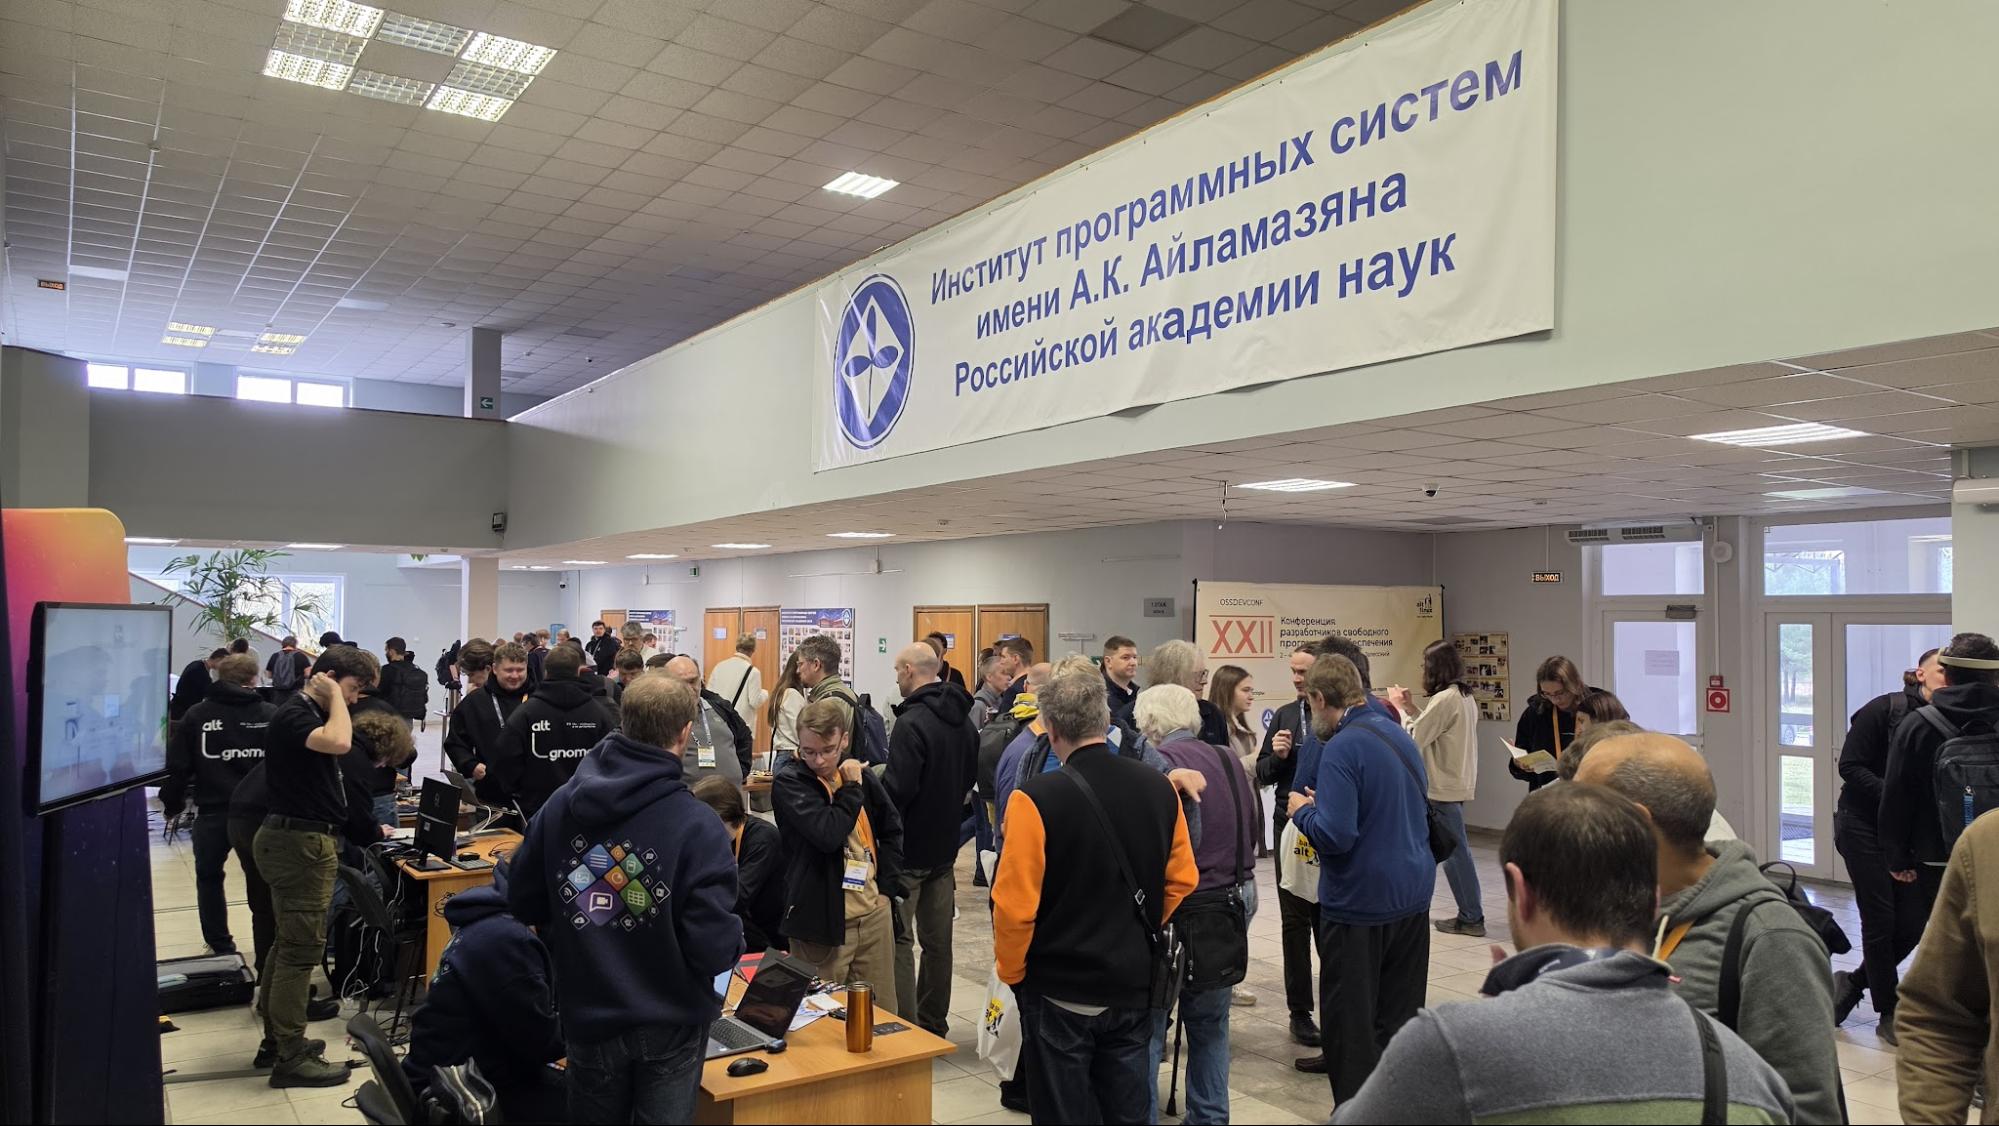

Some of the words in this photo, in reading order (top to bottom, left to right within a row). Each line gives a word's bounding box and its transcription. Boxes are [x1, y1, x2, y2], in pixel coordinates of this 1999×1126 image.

[931, 237, 1047, 304] Институт
[1056, 131, 1313, 259] программных
[1330, 50, 1523, 154] систем
[976, 285, 1061, 339] имени
[1069, 254, 1129, 308] А.К.
[1139, 172, 1408, 288] Айламазяна
[955, 318, 1119, 396] Российской
[1128, 271, 1320, 351] академии
[1338, 233, 1456, 298] наук
[1535, 574, 1559, 582] ВЫХОД
[1220, 598, 1264, 606] OSSDEVCONF
[1280, 617, 1336, 626] Конференция
[1211, 620, 1273, 653] XXII
[1280, 627, 1341, 637] разработчиков
[1343, 627, 1389, 637] свободного
[202, 720, 223, 731] alt
[531, 720, 551, 731] alt
[549, 748, 589, 761] gnom
[1294, 847, 1309, 857] alt
